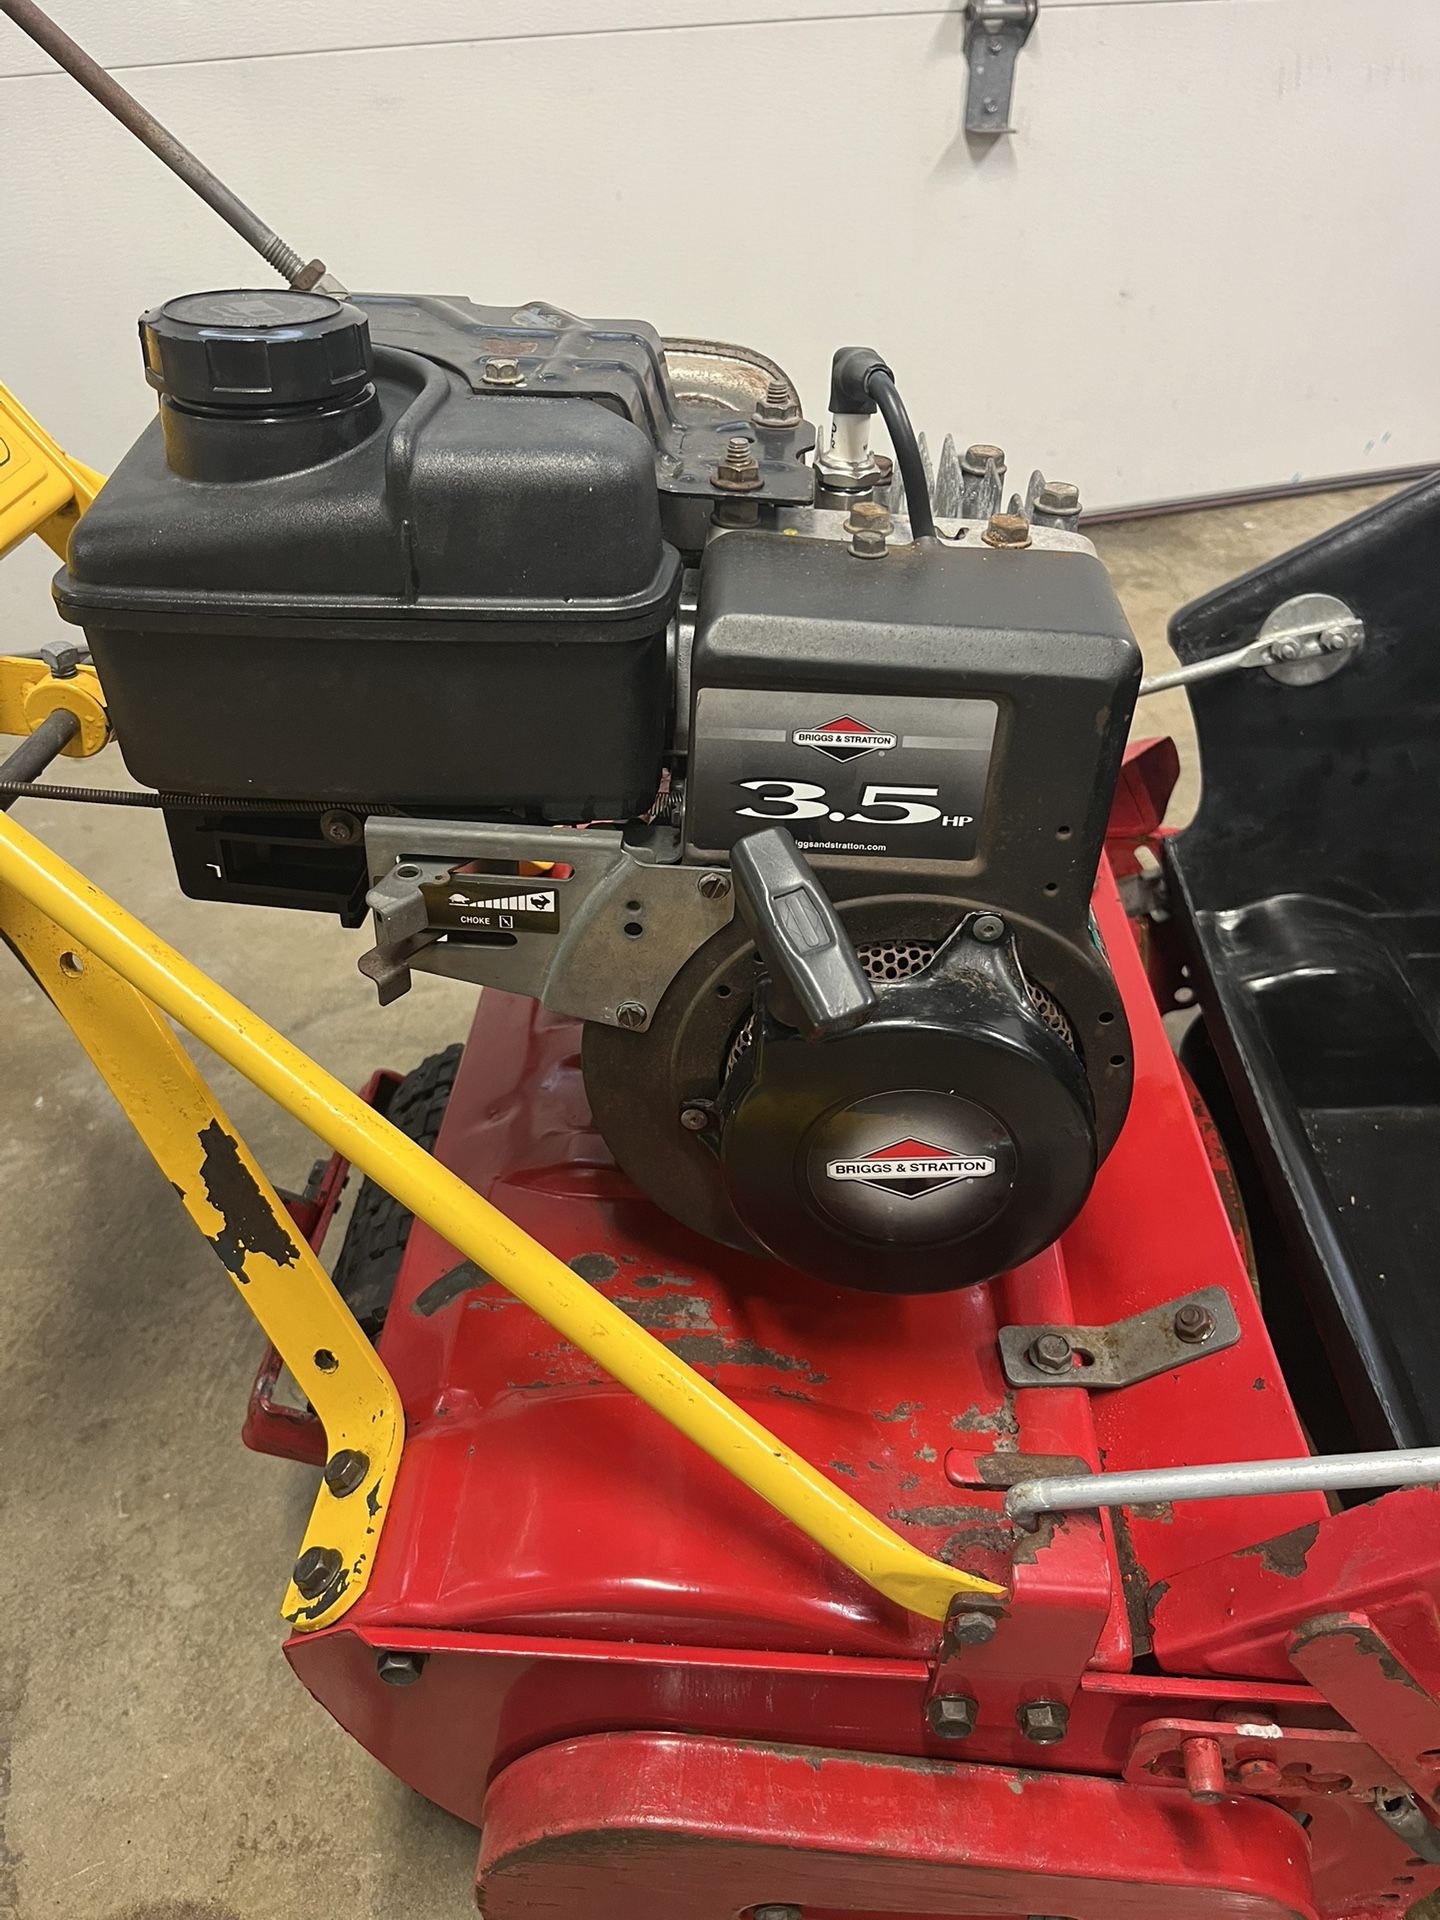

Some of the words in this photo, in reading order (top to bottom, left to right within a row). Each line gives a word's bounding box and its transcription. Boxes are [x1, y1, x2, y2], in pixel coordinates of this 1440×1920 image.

[798, 733, 834, 743] BRIGGS
[835, 735, 842, 743] &
[844, 735, 891, 745] STRATTON
[735, 780, 942, 825] 3.5
[942, 815, 974, 827] HP
[460, 915, 491, 925] CHOKE
[835, 1164, 892, 1175] BRIGGS
[896, 1163, 906, 1173] &
[910, 1161, 986, 1173] STRATTON
